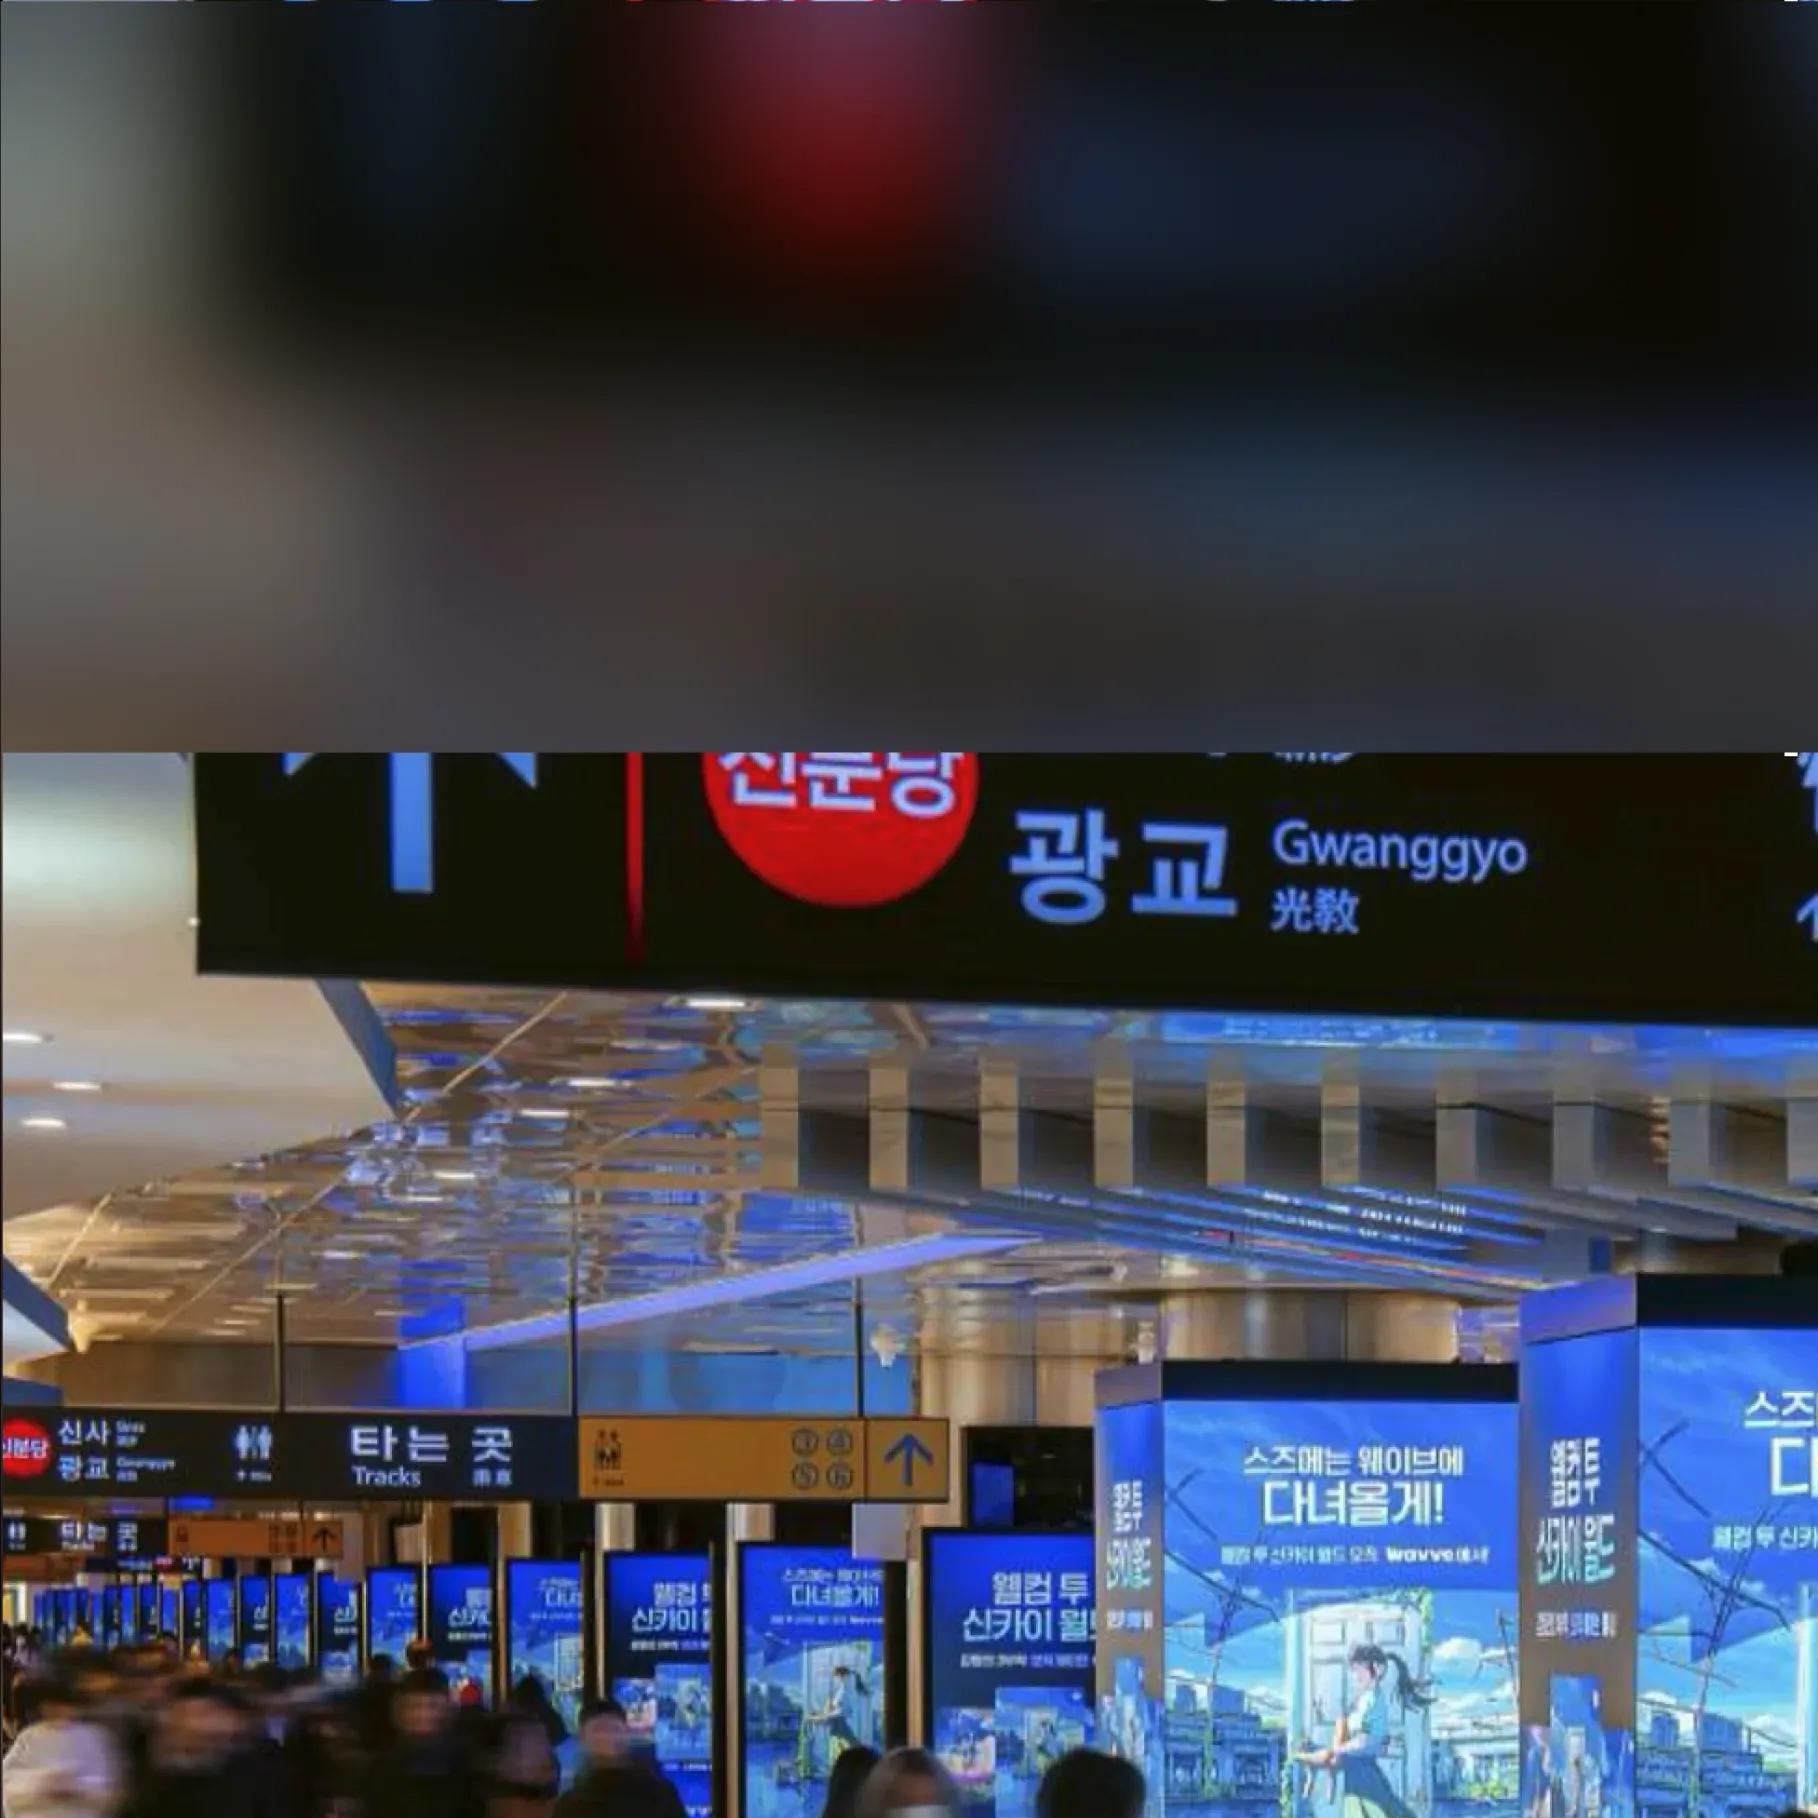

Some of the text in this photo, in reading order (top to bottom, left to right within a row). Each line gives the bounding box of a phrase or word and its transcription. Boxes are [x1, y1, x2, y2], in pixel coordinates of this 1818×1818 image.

[1010, 808, 1238, 924] 광교
[1272, 820, 1528, 882] Gwanggyo
[58, 1418, 110, 1447] 신사
[350, 1425, 512, 1463] 타는 곳
[352, 1467, 422, 1488] Tracks
[1243, 1445, 1464, 1477] 스즈메는 웨이브에
[1262, 1479, 1444, 1528] 다녀올게!
[1059, 1573, 1089, 1605] 투
[963, 1607, 1053, 1642] 신카이
